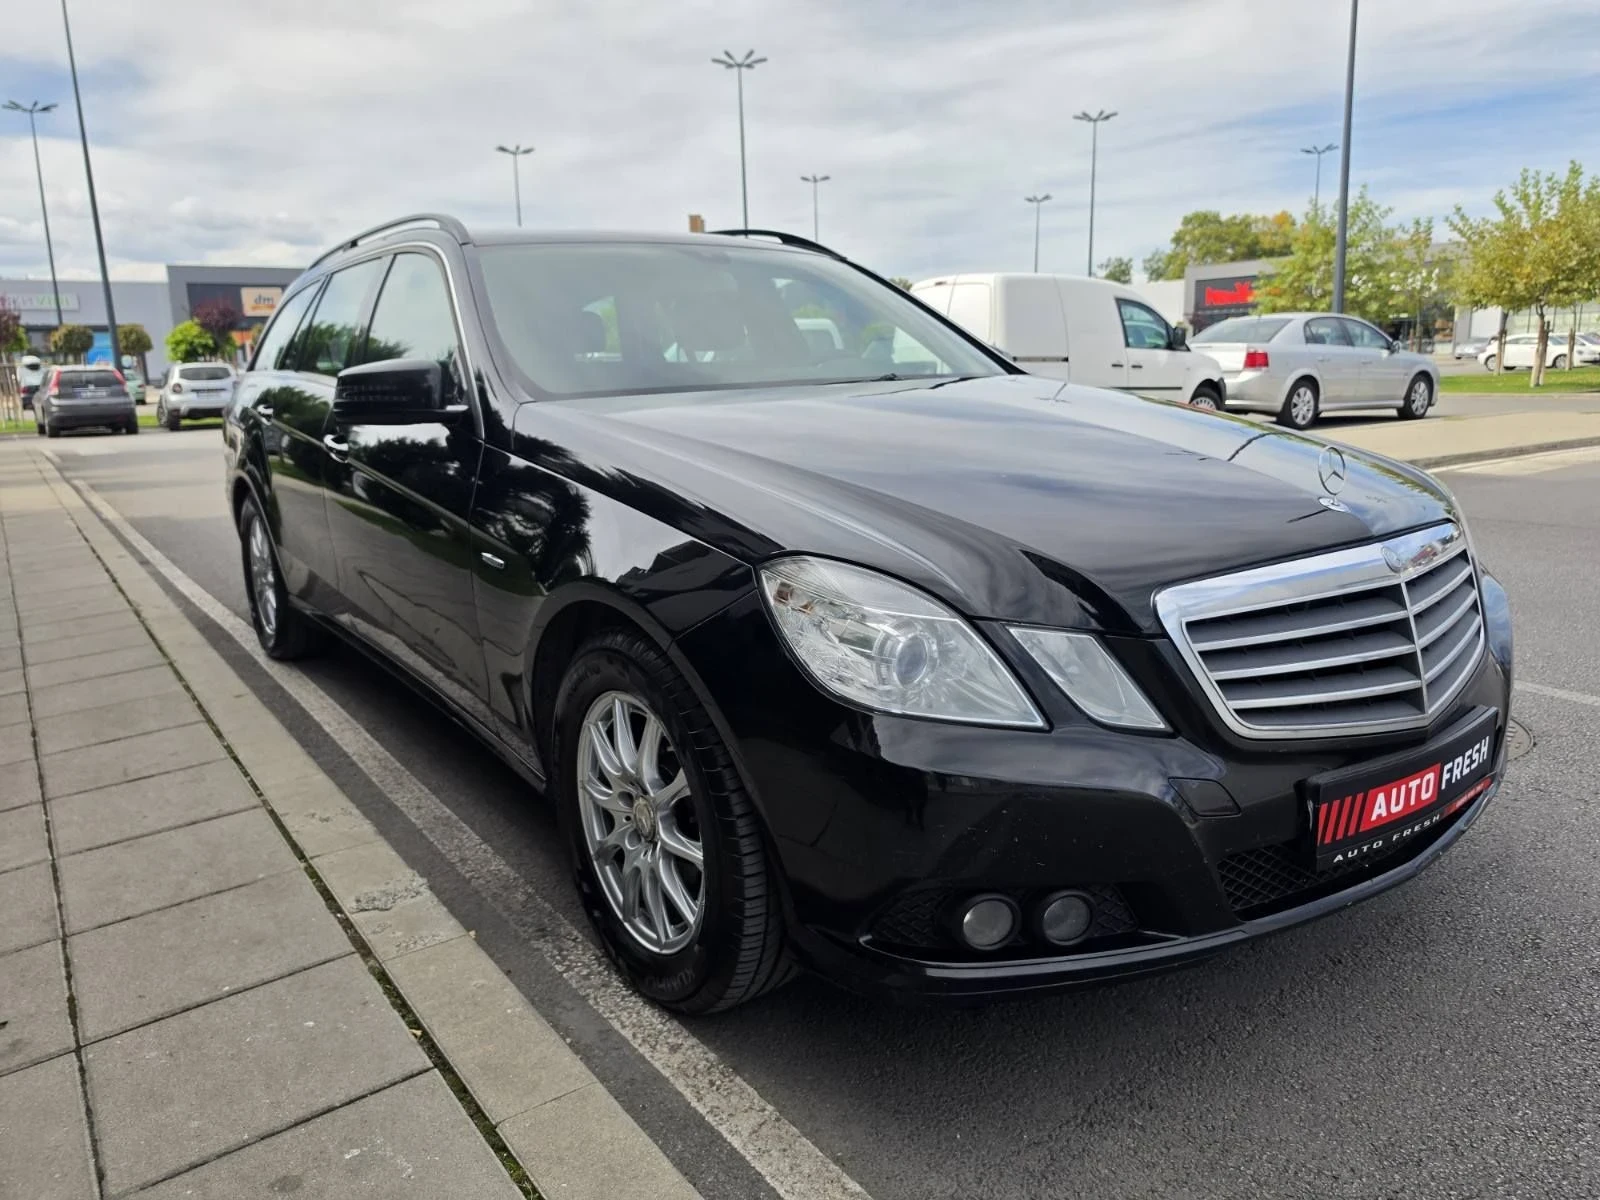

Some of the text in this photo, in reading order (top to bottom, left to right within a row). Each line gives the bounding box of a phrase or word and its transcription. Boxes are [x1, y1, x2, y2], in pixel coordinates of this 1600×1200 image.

[1370, 772, 1435, 822] AUTO
[1441, 736, 1490, 790] FRESH
[1333, 815, 1440, 863] AUTO FRESH
